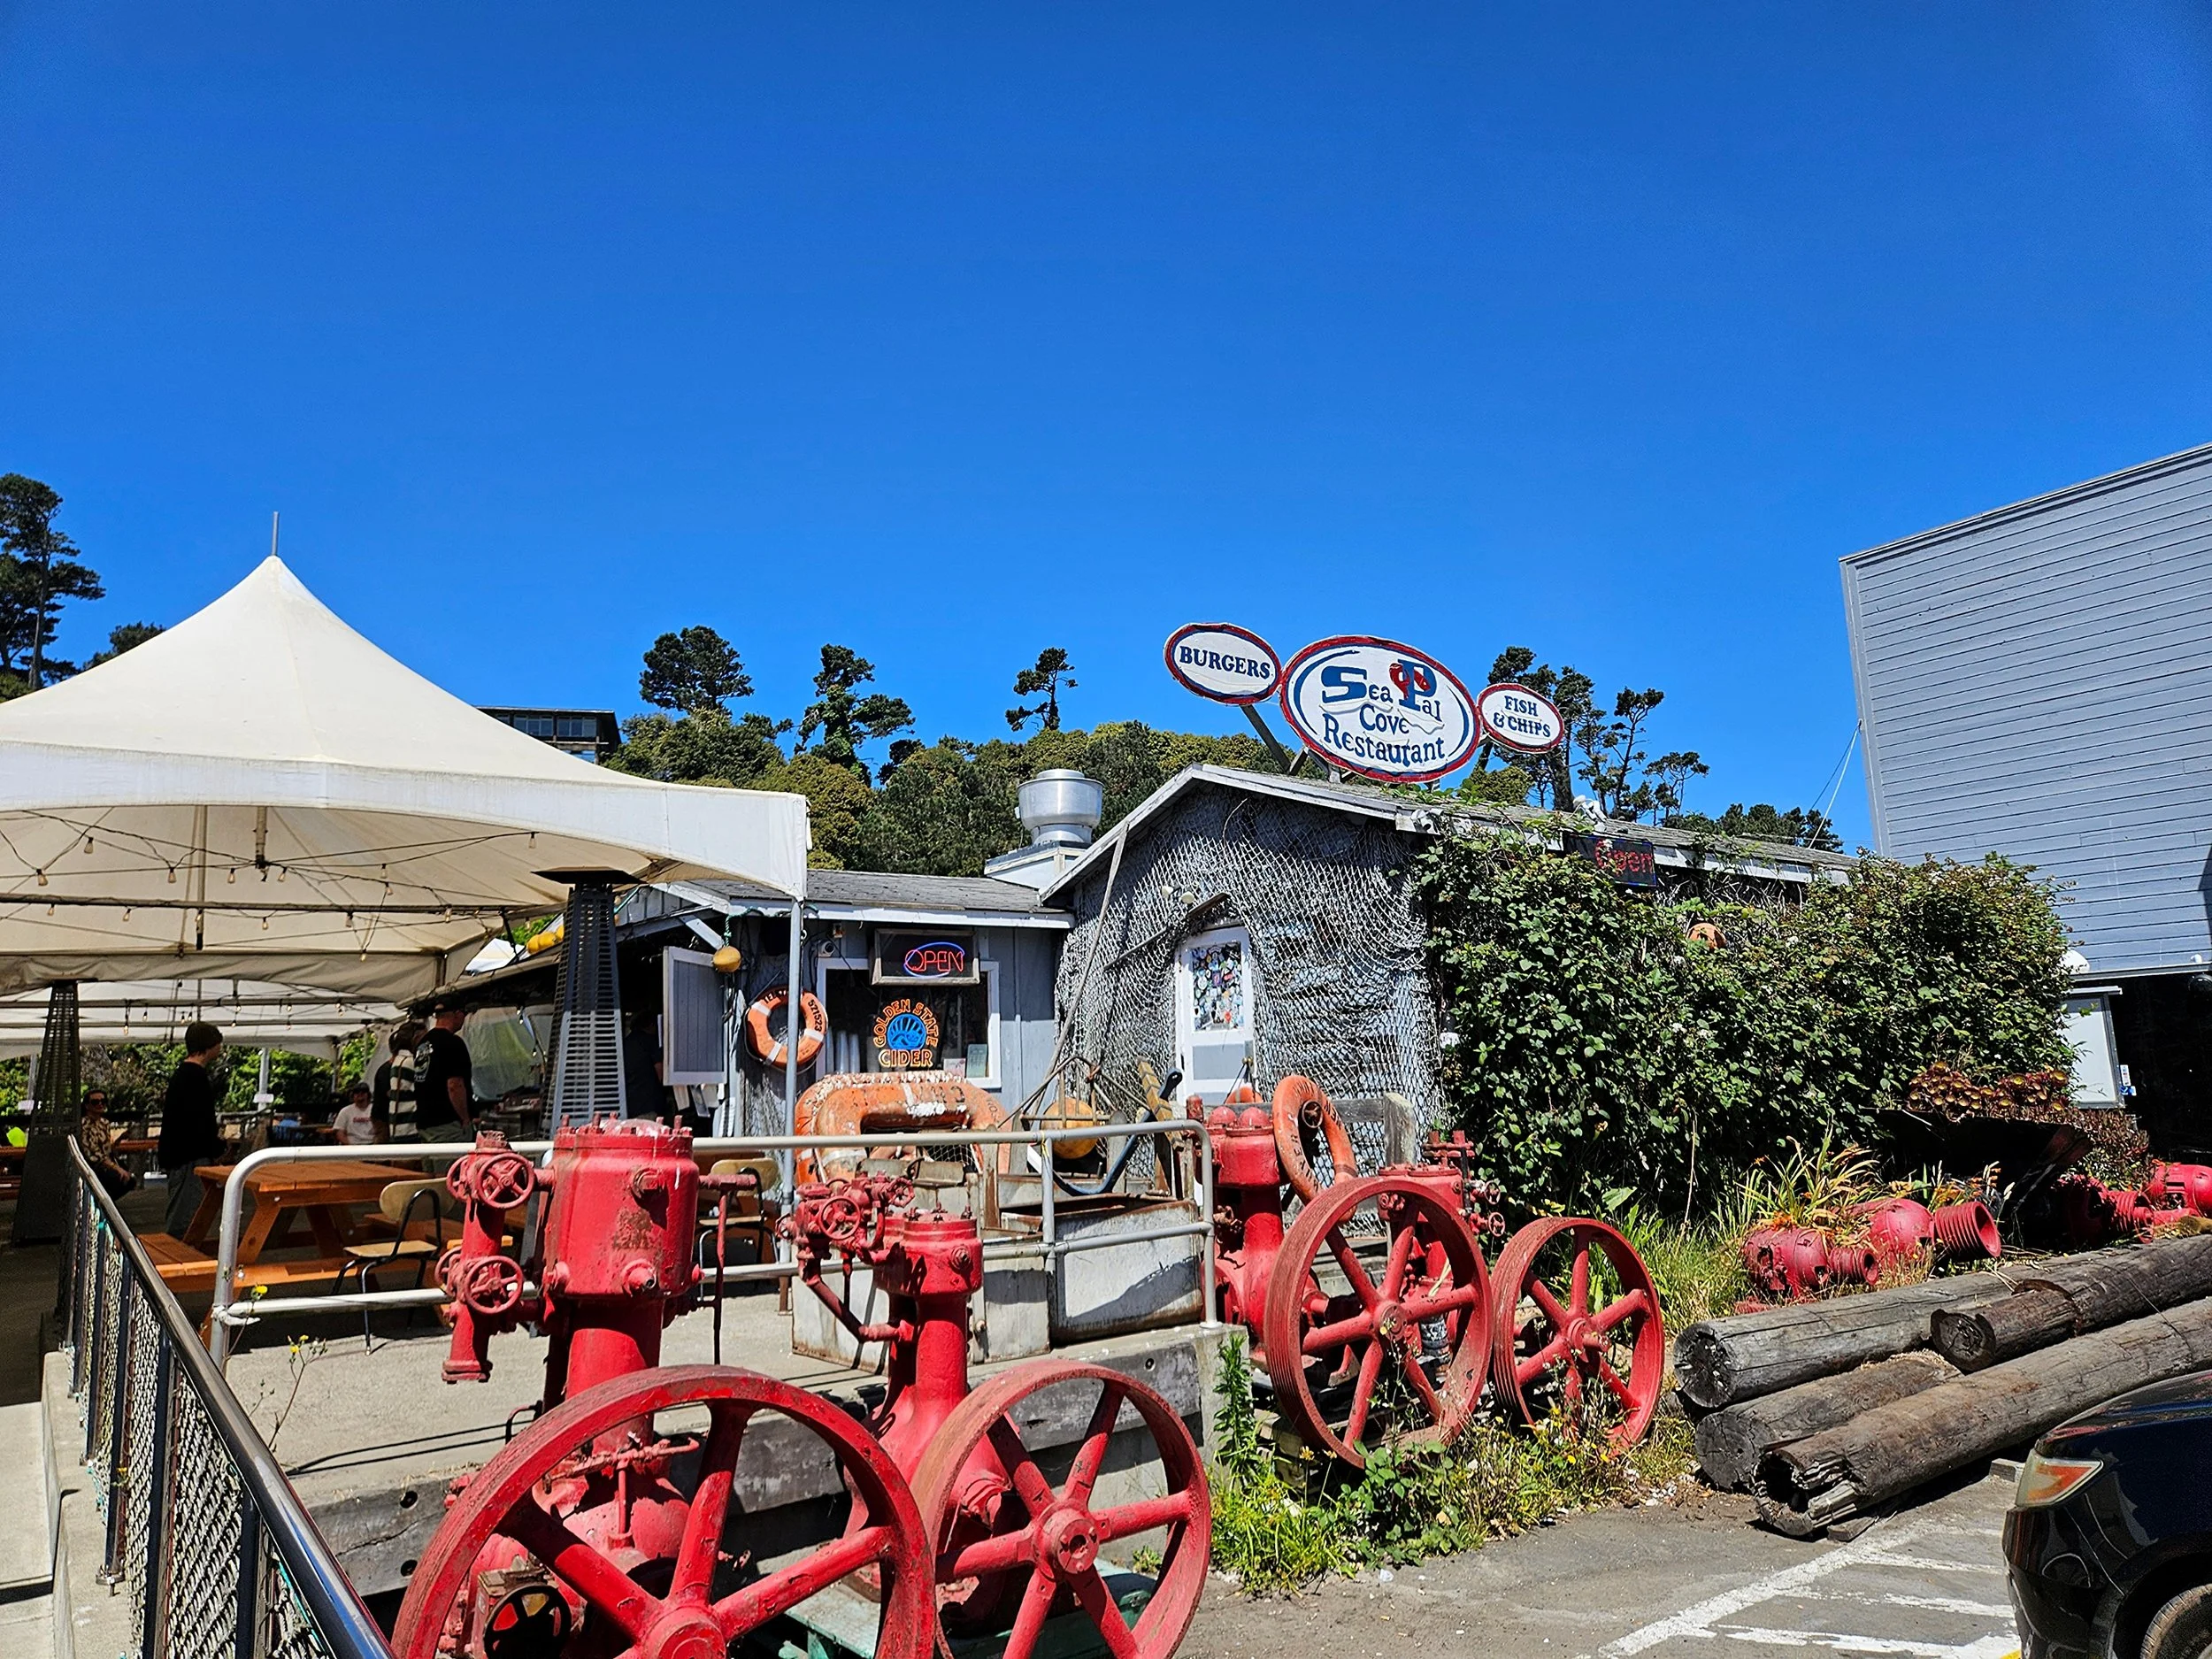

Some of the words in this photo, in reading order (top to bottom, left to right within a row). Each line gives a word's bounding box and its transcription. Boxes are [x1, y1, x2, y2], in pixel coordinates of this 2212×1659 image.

[1179, 646, 1271, 680] BURGERS
[1321, 664, 1394, 703] Sea
[1395, 657, 1441, 721] Pal
[1359, 706, 1409, 735] Cove
[1504, 695, 1539, 717] FISH
[1323, 713, 1446, 767] Restaurant
[904, 949, 964, 972] OPEN
[808, 999, 823, 1032] 521523
[873, 999, 910, 1048] GOLDEN
[912, 1002, 939, 1048] STATE
[879, 1049, 933, 1068] CIDER
